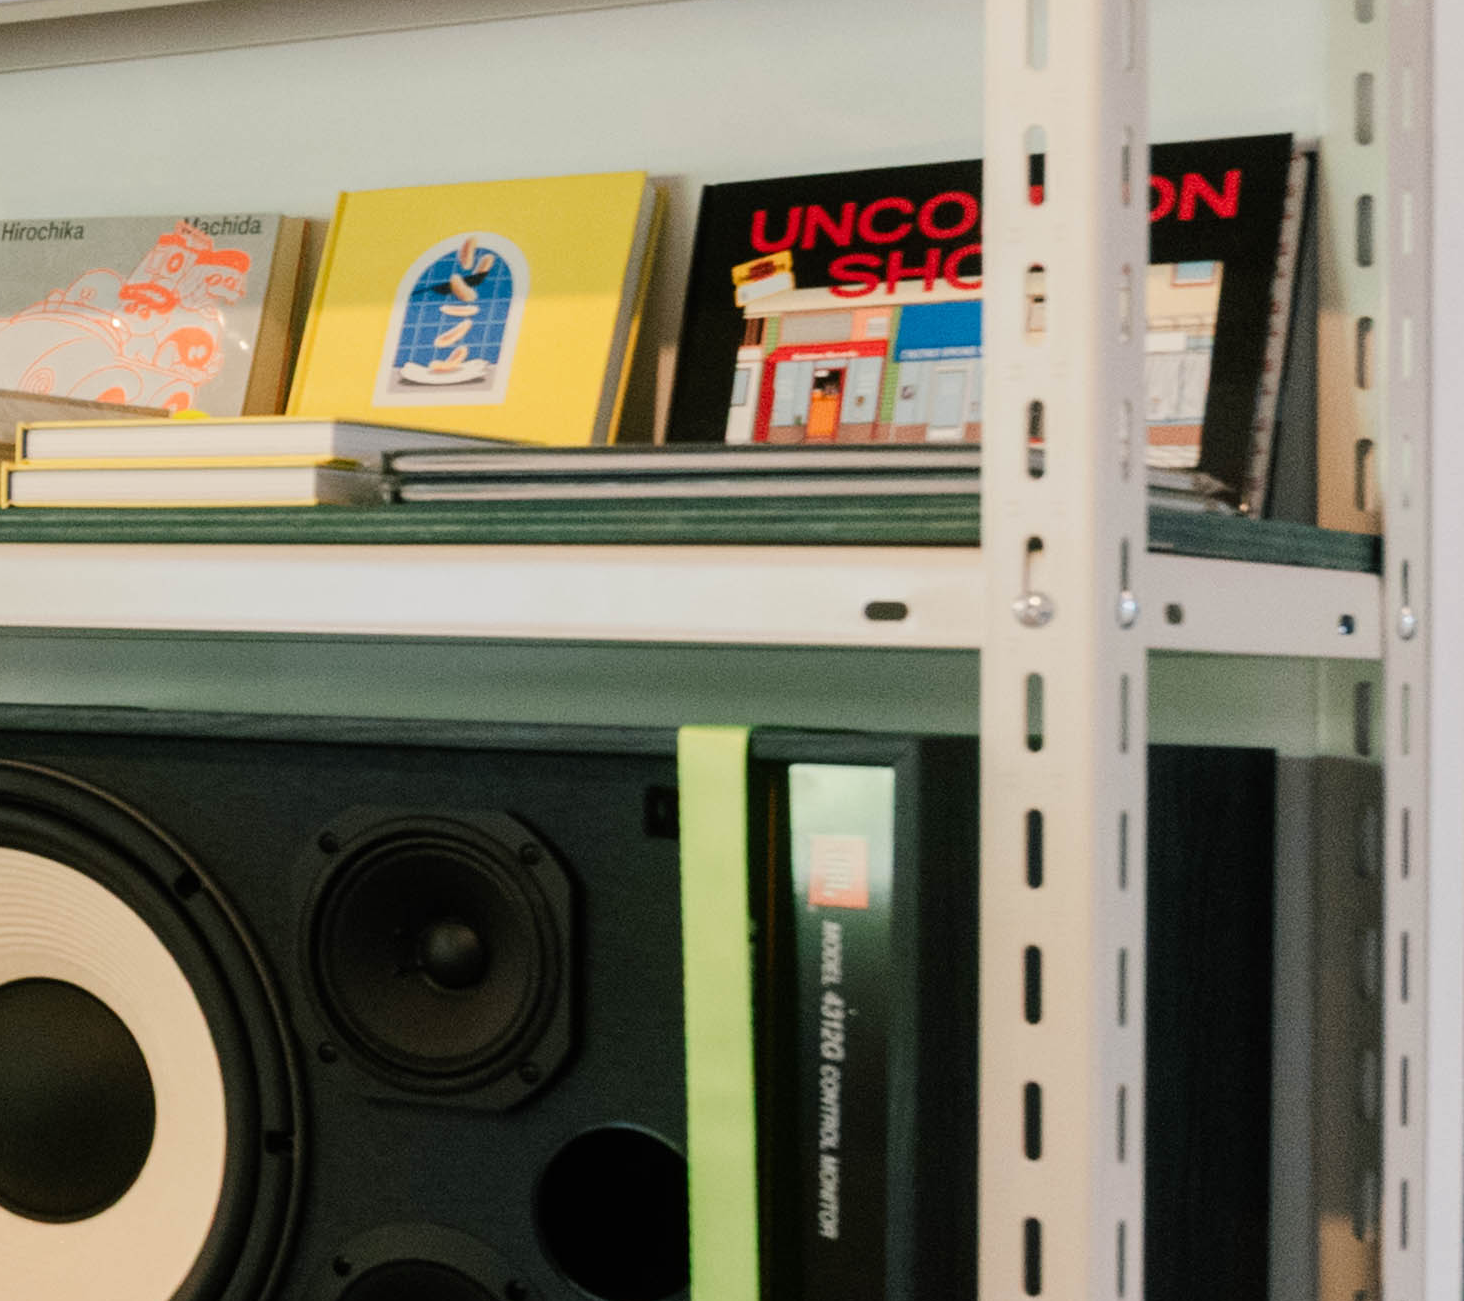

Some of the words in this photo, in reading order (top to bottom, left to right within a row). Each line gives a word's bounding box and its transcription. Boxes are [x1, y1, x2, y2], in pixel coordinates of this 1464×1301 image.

[1, 221, 85, 244] Hirochika
[180, 214, 263, 239] Machida
[750, 169, 1243, 254] UNCOON
[819, 920, 843, 986] MODEL
[817, 1064, 843, 1150] CONTROL
[817, 1155, 842, 1240] MONITOR
